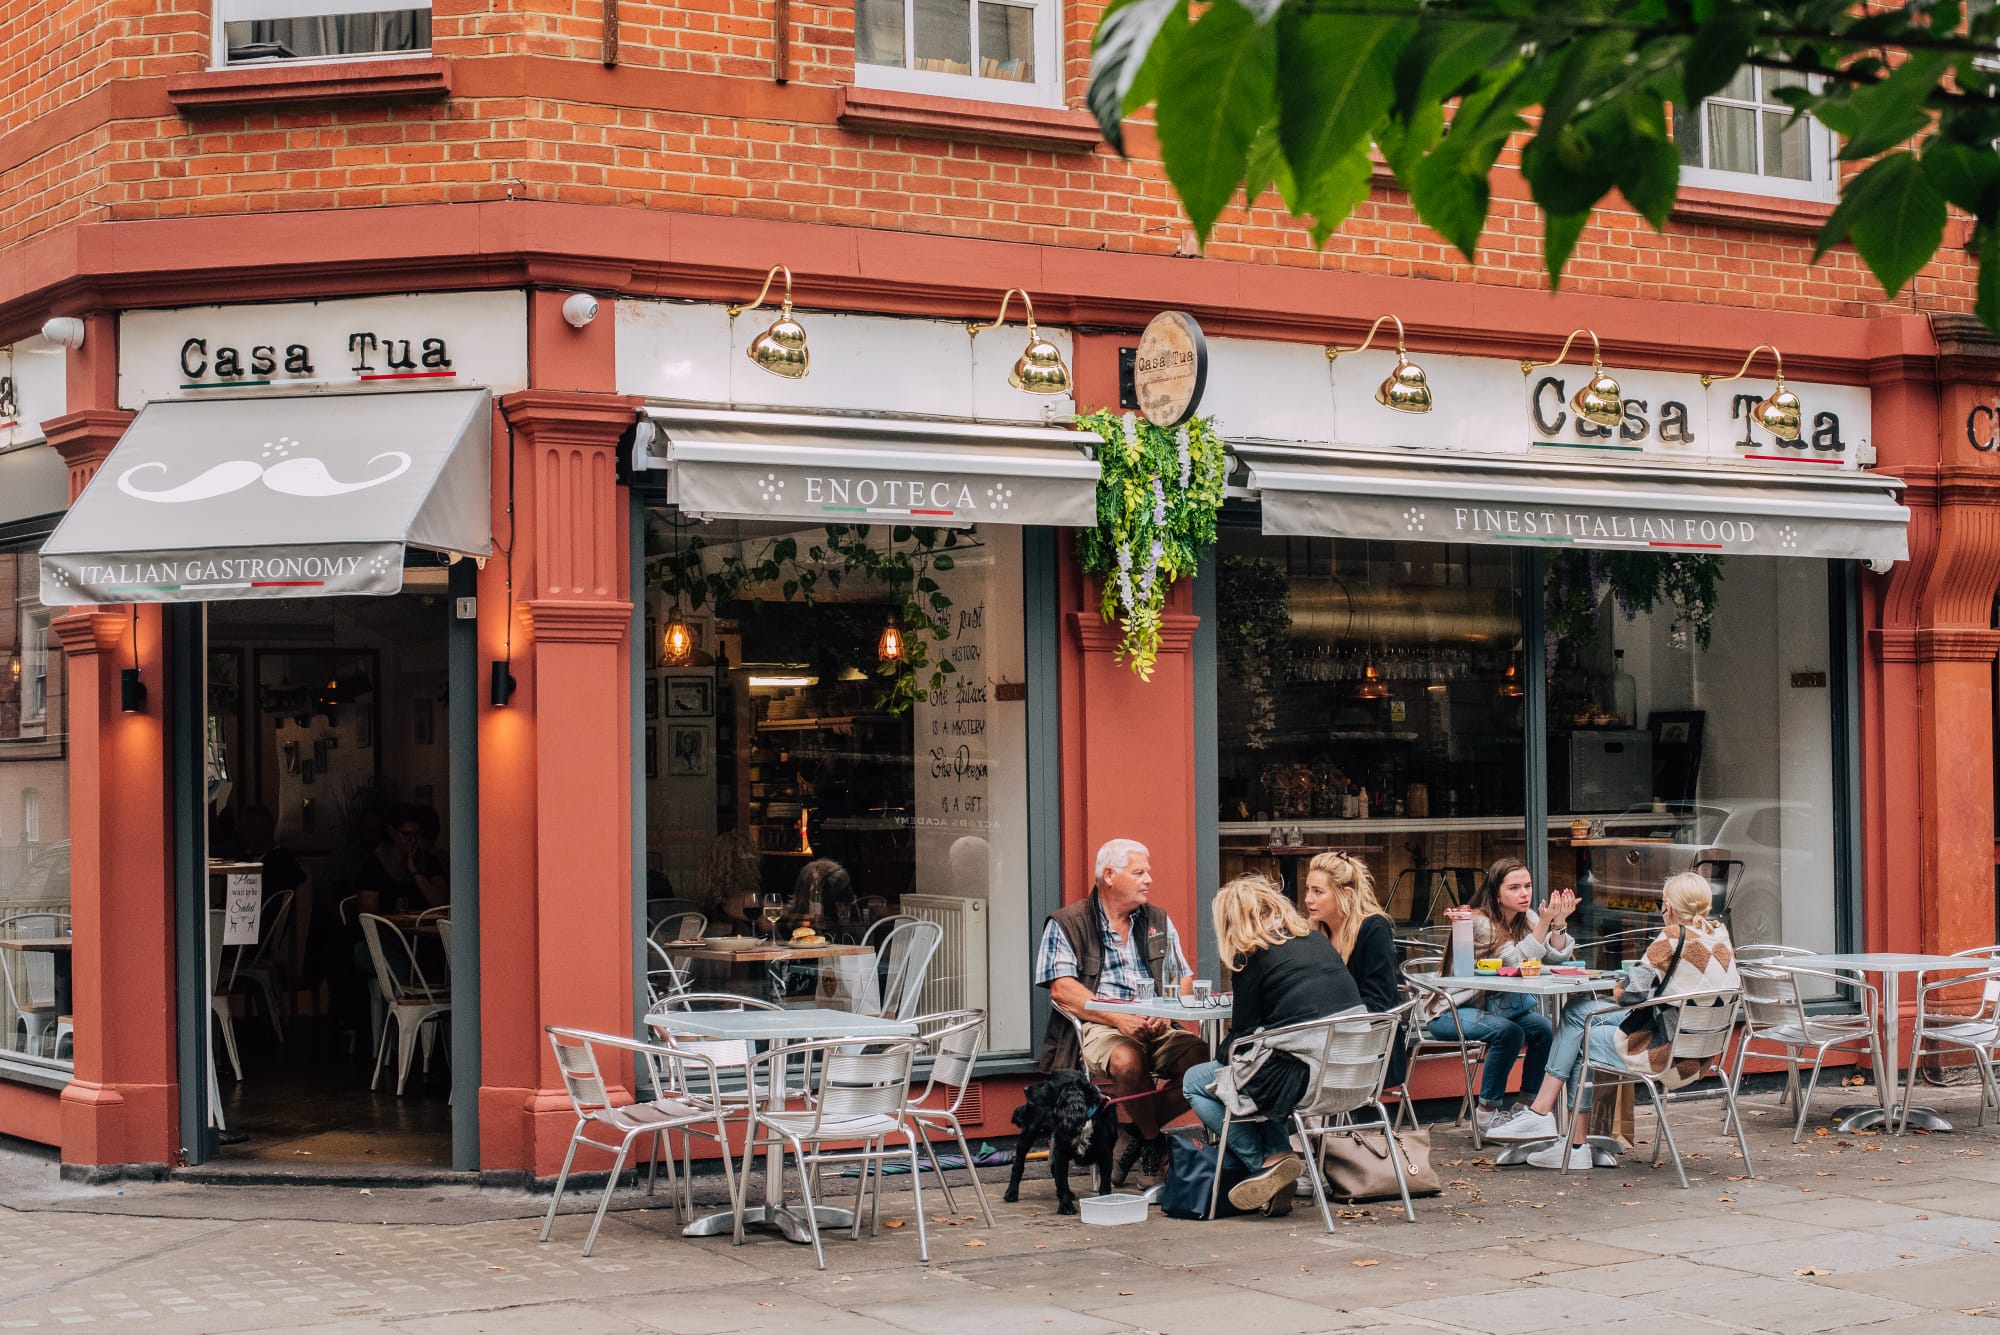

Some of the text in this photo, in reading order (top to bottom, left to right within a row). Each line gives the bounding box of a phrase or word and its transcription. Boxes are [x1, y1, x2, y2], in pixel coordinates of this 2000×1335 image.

[180, 332, 453, 379] Casa Tua
[1138, 350, 1194, 371] Casa Tua
[1732, 393, 1846, 453] Ta
[803, 477, 977, 509] ENOTECA
[1454, 507, 1756, 543] FINEST ITALIAN FOOD
[79, 556, 364, 586] ITALIAN GASTRONOMY
[951, 645, 982, 662] HISTORY
[942, 719, 949, 736] A
[953, 719, 985, 736] MYSTERY
[952, 795, 960, 812] A
